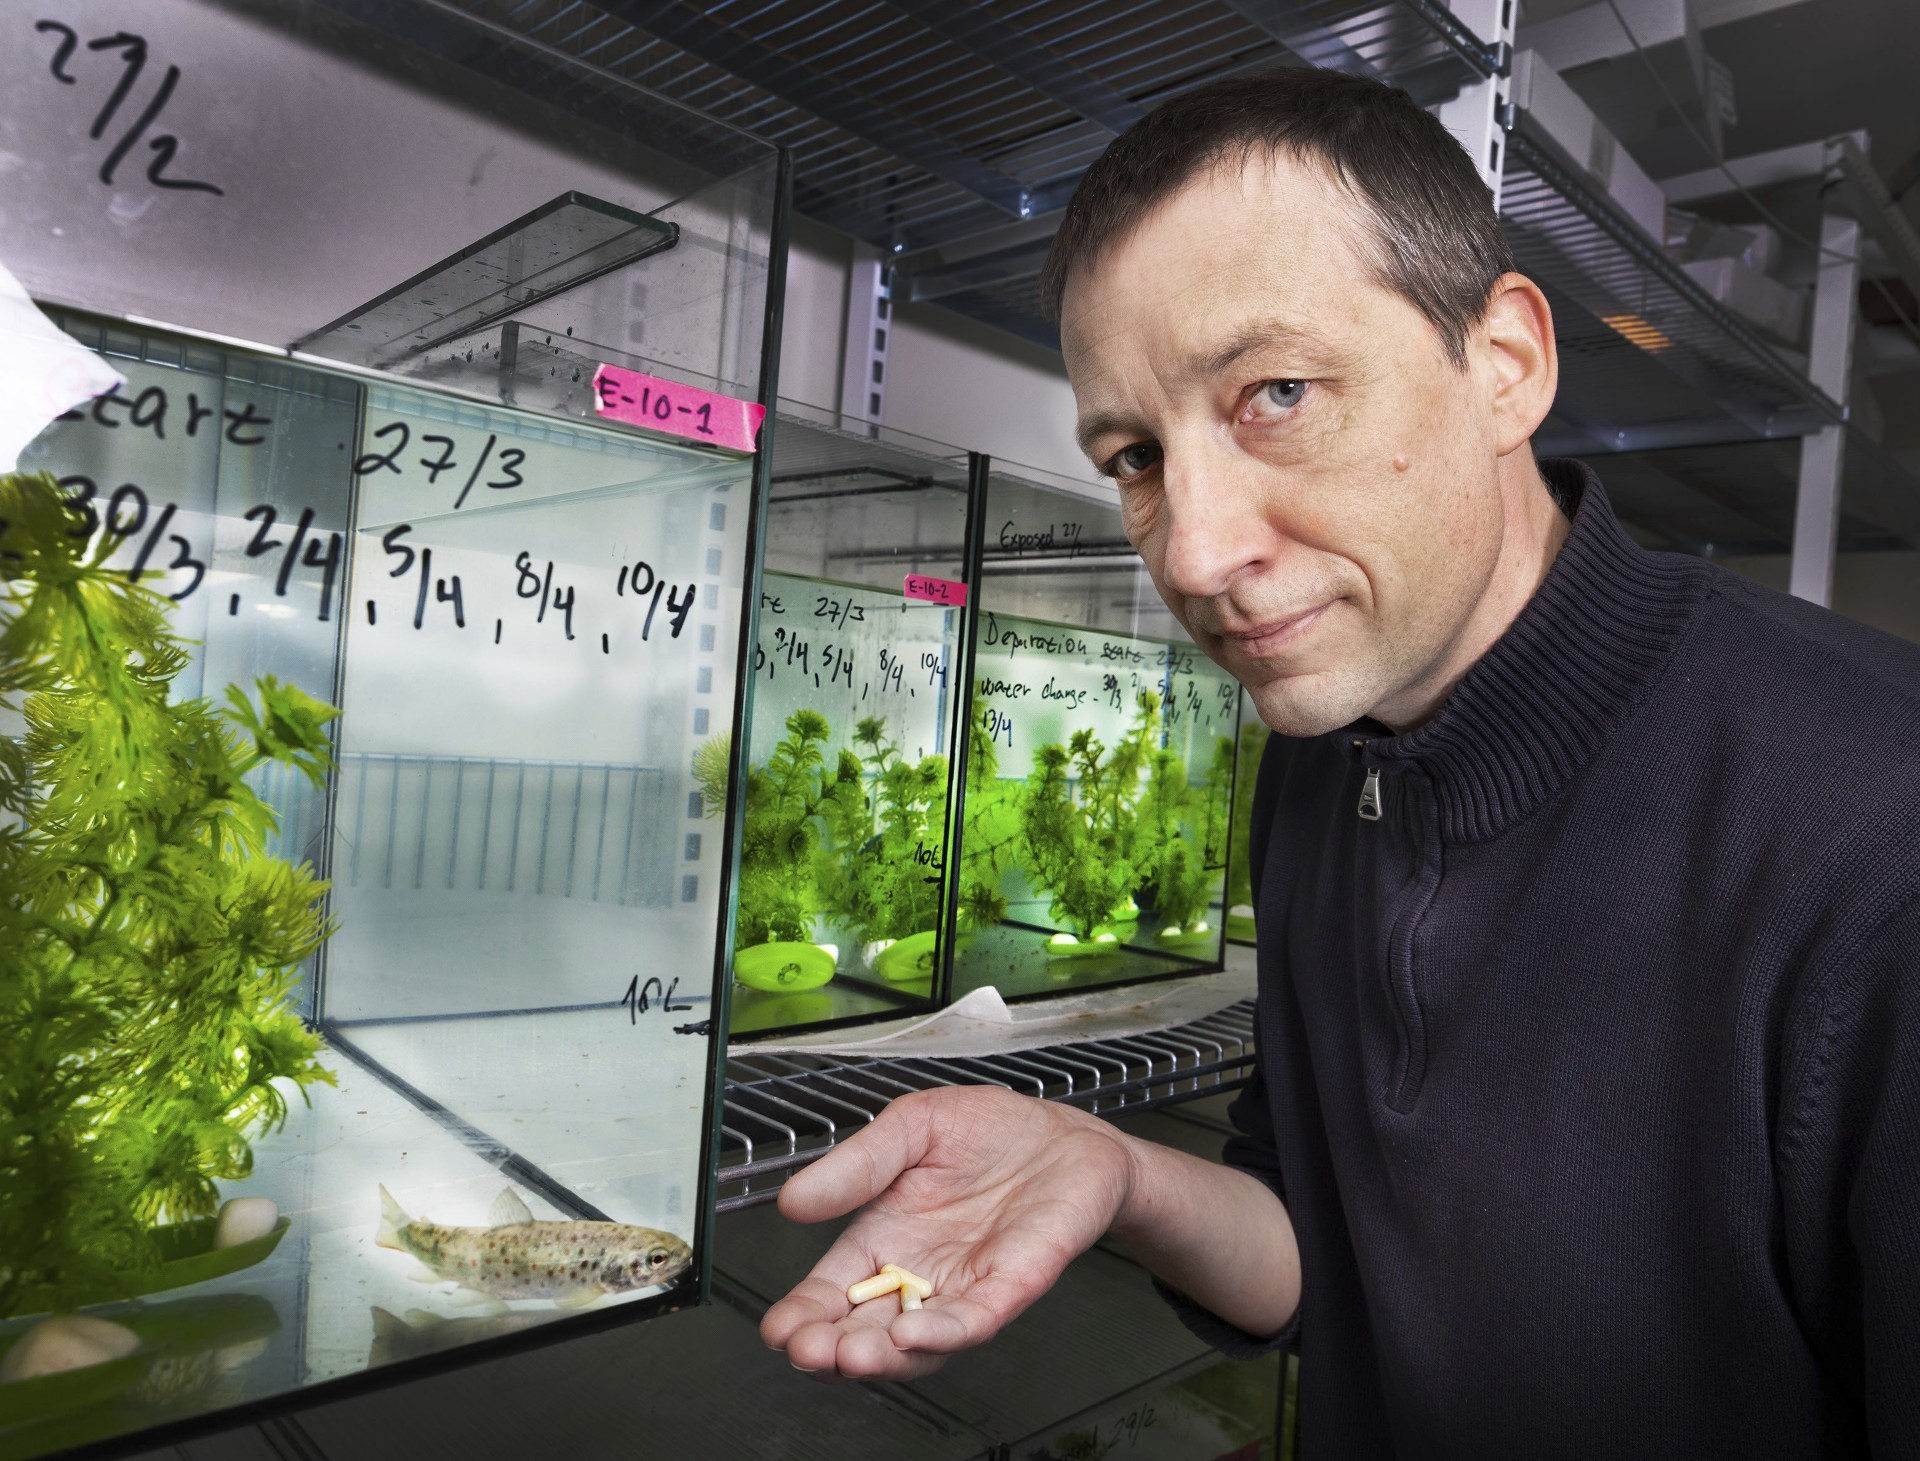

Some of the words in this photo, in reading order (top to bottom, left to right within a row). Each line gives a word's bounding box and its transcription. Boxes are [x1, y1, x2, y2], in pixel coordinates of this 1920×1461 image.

[36, 20, 223, 195] 27/2
[600, 376, 714, 435] E-10-1
[56, 382, 272, 445] tart
[355, 422, 526, 509] 27/3
[1000, 520, 1055, 556] Exposed
[617, 561, 696, 642] 10/4
[909, 580, 949, 598] E-10-2
[814, 597, 865, 630] 27/3
[984, 611, 1087, 659] Depuration
[921, 652, 947, 688] 10/4
[983, 709, 1012, 747] 13/4
